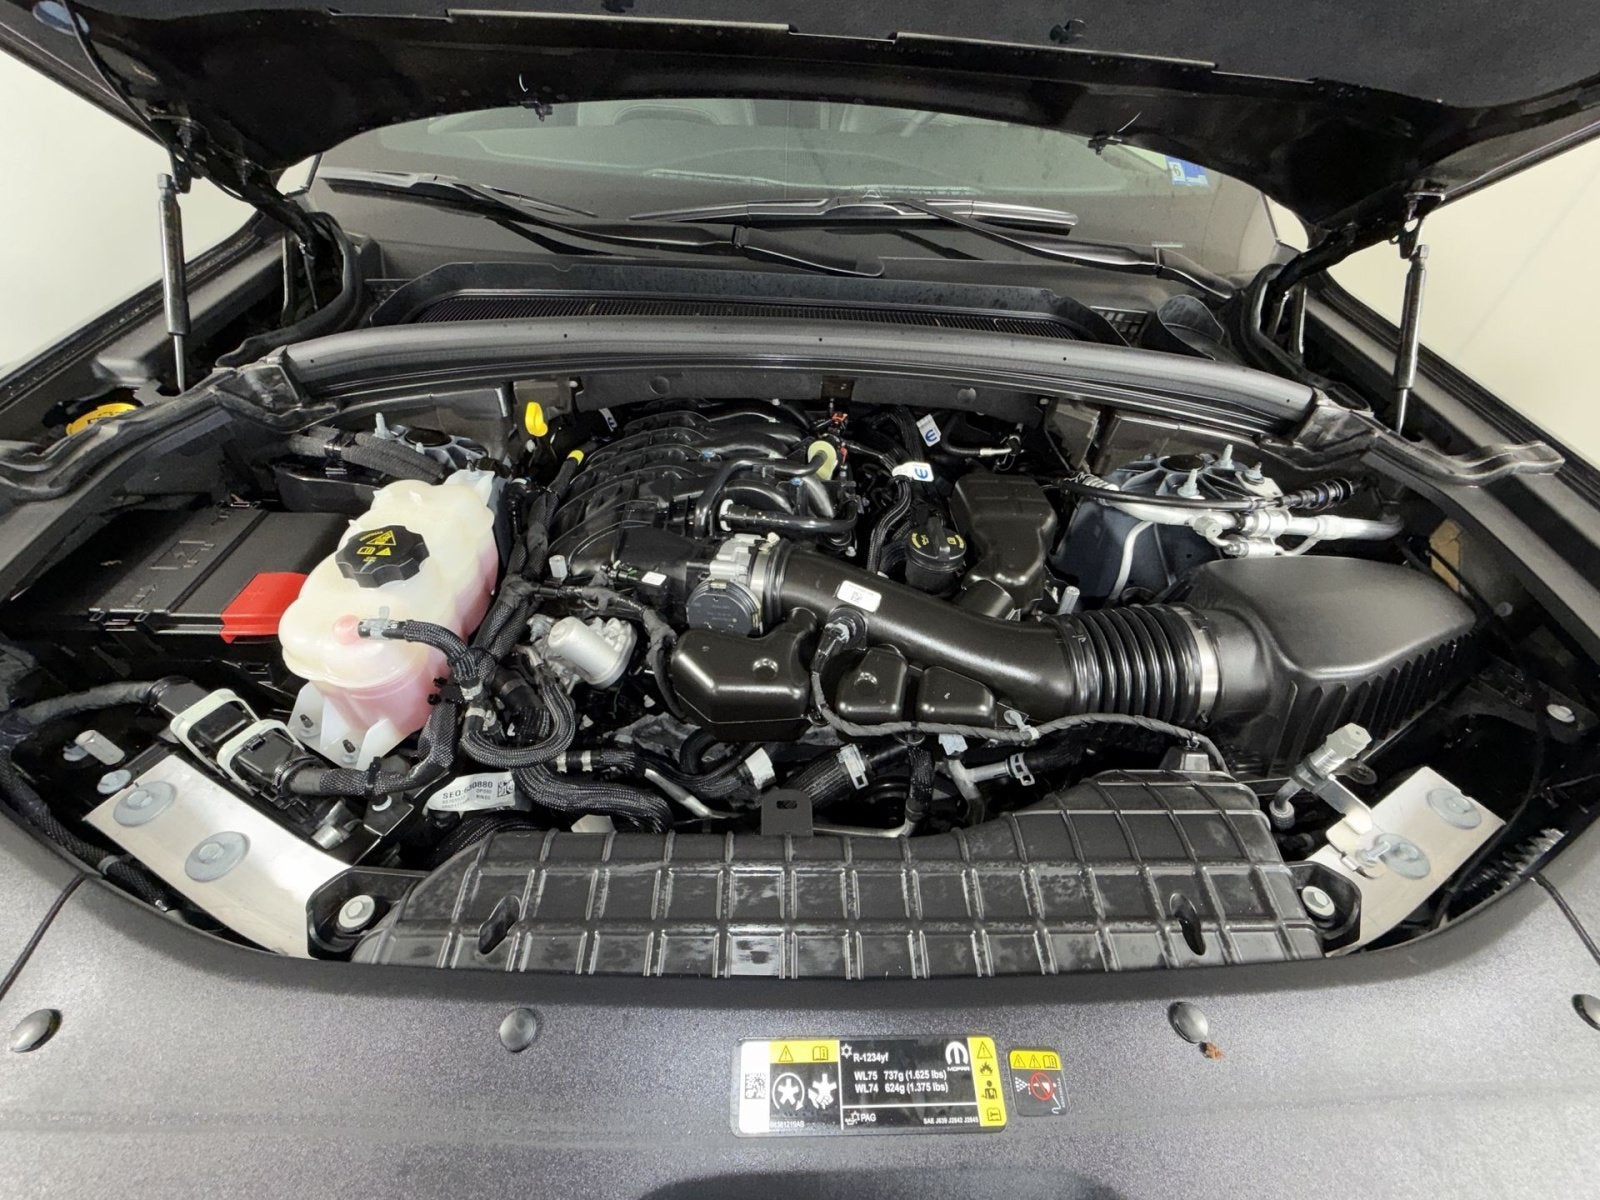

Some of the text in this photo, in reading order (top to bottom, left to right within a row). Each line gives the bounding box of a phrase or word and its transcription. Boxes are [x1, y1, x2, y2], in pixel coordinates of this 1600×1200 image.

[853, 1052, 889, 1064] R-1234yf
[854, 1069, 947, 1082] WL75 737g (1.625 lbs)
[855, 1082, 949, 1094] WL74 624g (1.375 lbs)
[860, 1112, 876, 1122] PAG
